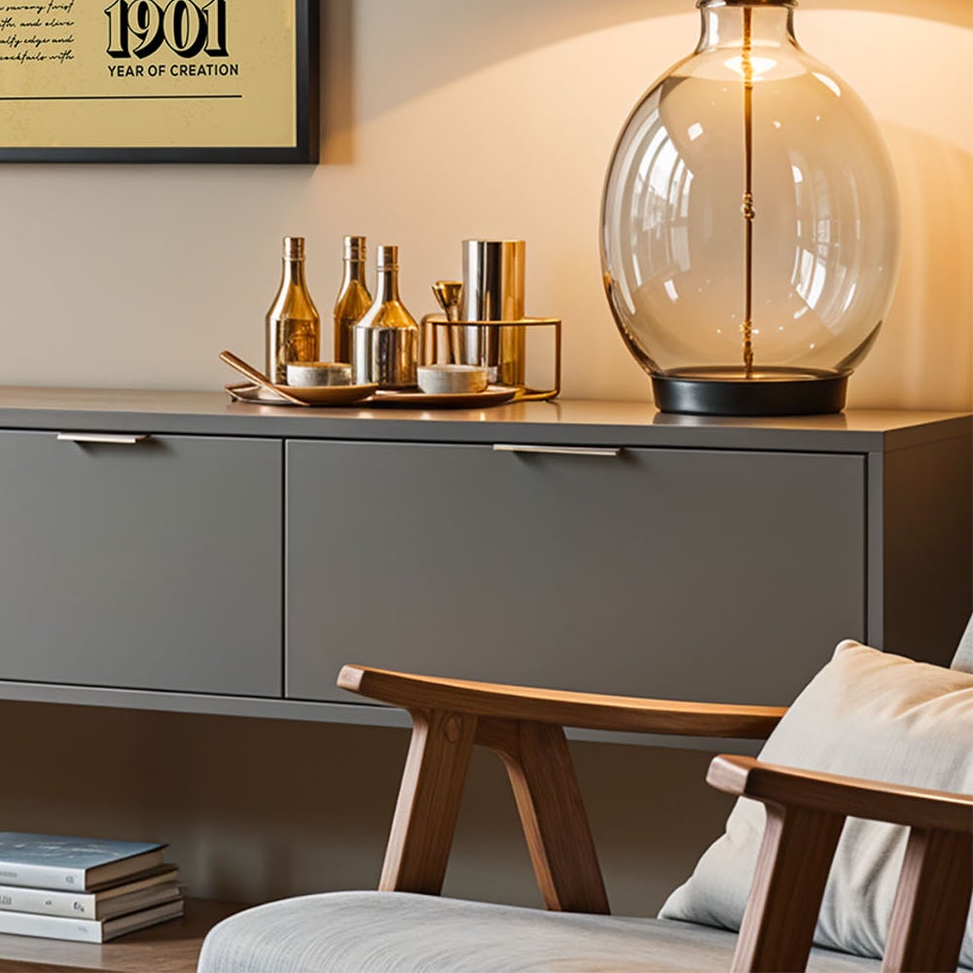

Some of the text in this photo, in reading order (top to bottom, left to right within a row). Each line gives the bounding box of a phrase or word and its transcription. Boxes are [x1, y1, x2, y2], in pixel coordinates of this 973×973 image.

[6, 5, 46, 14] savory
[46, 0, 75, 14] twist
[19, 18, 43, 27] and
[45, 19, 75, 27] olive
[23, 36, 51, 48] edge
[51, 34, 75, 44] and
[0, 50, 48, 64] cocktails
[48, 49, 75, 64] with
[108, 64, 239, 77] YEAR OF CREATION
